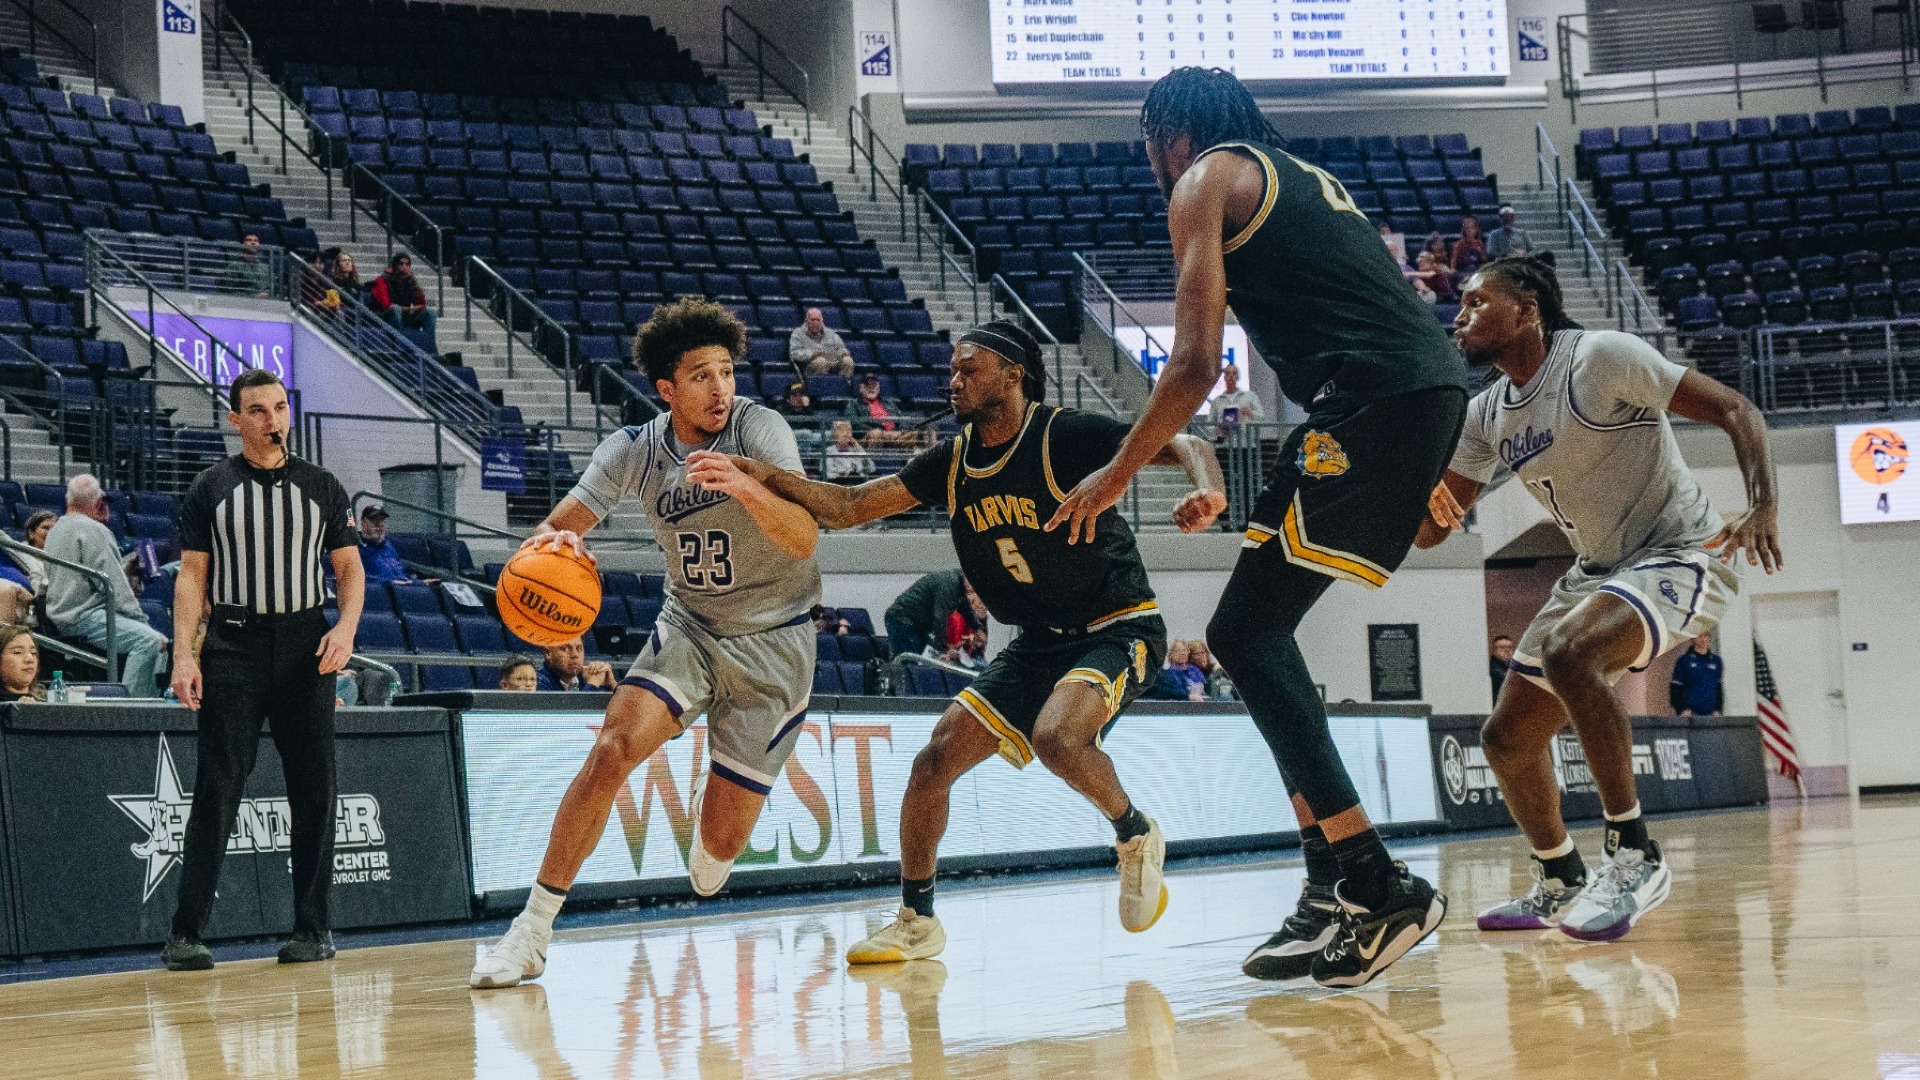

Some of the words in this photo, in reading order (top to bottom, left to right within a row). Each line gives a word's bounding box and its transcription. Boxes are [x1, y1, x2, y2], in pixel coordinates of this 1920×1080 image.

[167, 17, 192, 32] 113
[1008, 15, 1014, 25] 5
[1044, 15, 1078, 25] Wright
[1137, 14, 1143, 24] 0
[1168, 14, 1174, 23] 0
[1197, 14, 1203, 23] 0
[1522, 20, 1543, 31] 116
[865, 34, 886, 45] 114
[1007, 33, 1017, 43] 15
[1026, 33, 1048, 43] Noel
[1050, 32, 1104, 43] Duplechain
[1138, 32, 1144, 41] 0
[1169, 32, 1174, 41] 0
[1199, 32, 1205, 41] 0
[1228, 31, 1234, 40] 0
[1007, 51, 1018, 60] 22
[1065, 51, 1092, 60] Smith
[1170, 49, 1175, 59] 0
[1229, 49, 1235, 59] 0
[1273, 49, 1284, 58] 23
[1294, 48, 1325, 58] Joseph
[1523, 47, 1547, 60] 115
[864, 61, 888, 75] 115
[1063, 67, 1086, 77] TEAM
[1089, 67, 1121, 77] TOTALS
[1330, 63, 1352, 73] TEAM
[1356, 63, 1387, 73] TOTALS
[1499, 426, 1554, 465] Abilene
[675, 529, 734, 589] 23
[994, 537, 1034, 584] 5
[520, 586, 582, 628] Wilson
[586, 723, 893, 877] WST
[371, 869, 391, 881] GMC
